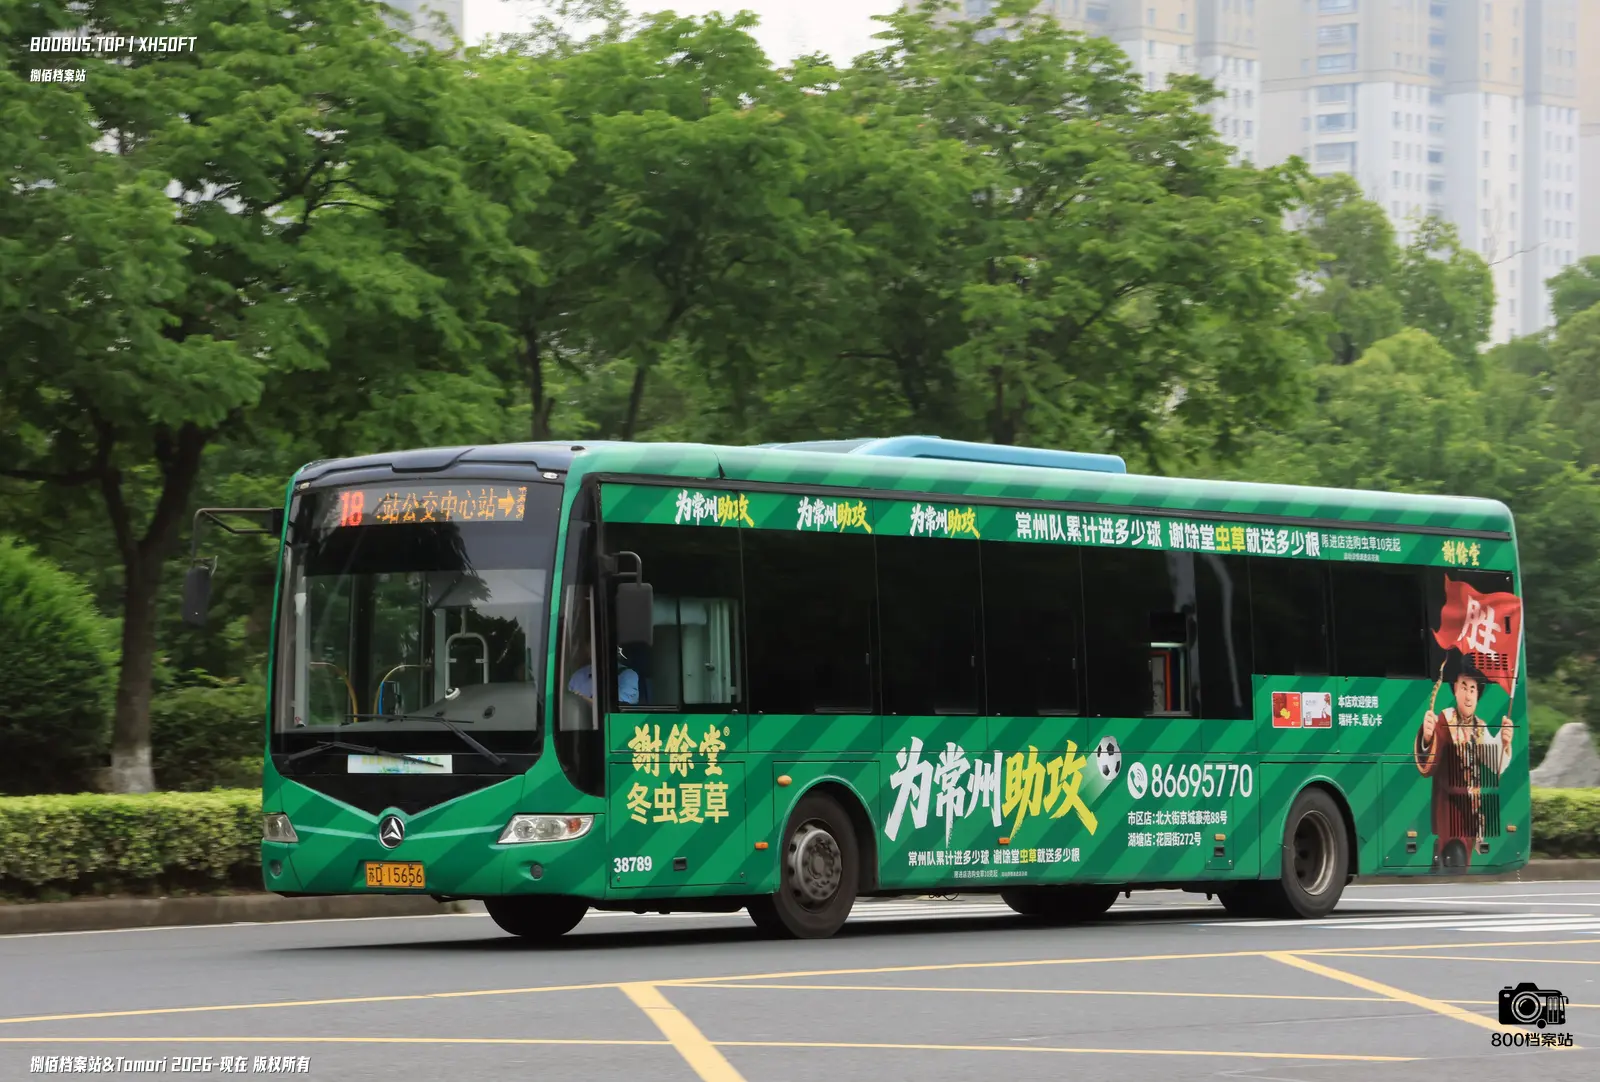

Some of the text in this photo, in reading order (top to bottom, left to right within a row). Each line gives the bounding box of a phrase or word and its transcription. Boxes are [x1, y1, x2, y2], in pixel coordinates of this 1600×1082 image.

[340, 491, 364, 527] 18
[675, 489, 754, 527] 为常州助攻
[796, 496, 872, 534] 为常州助攻
[910, 502, 980, 539] 为常州助攻
[1015, 511, 1162, 547] 常州队累计进多少球
[1456, 595, 1502, 661] 胜
[1337, 695, 1379, 708] 本店欢迎使用
[884, 736, 1099, 848] 为常州助攻
[1151, 763, 1253, 798] 86695770
[626, 781, 729, 824] 冬虫夏草
[613, 856, 652, 873] 38789
[908, 851, 989, 866] 常州队累计进多少球
